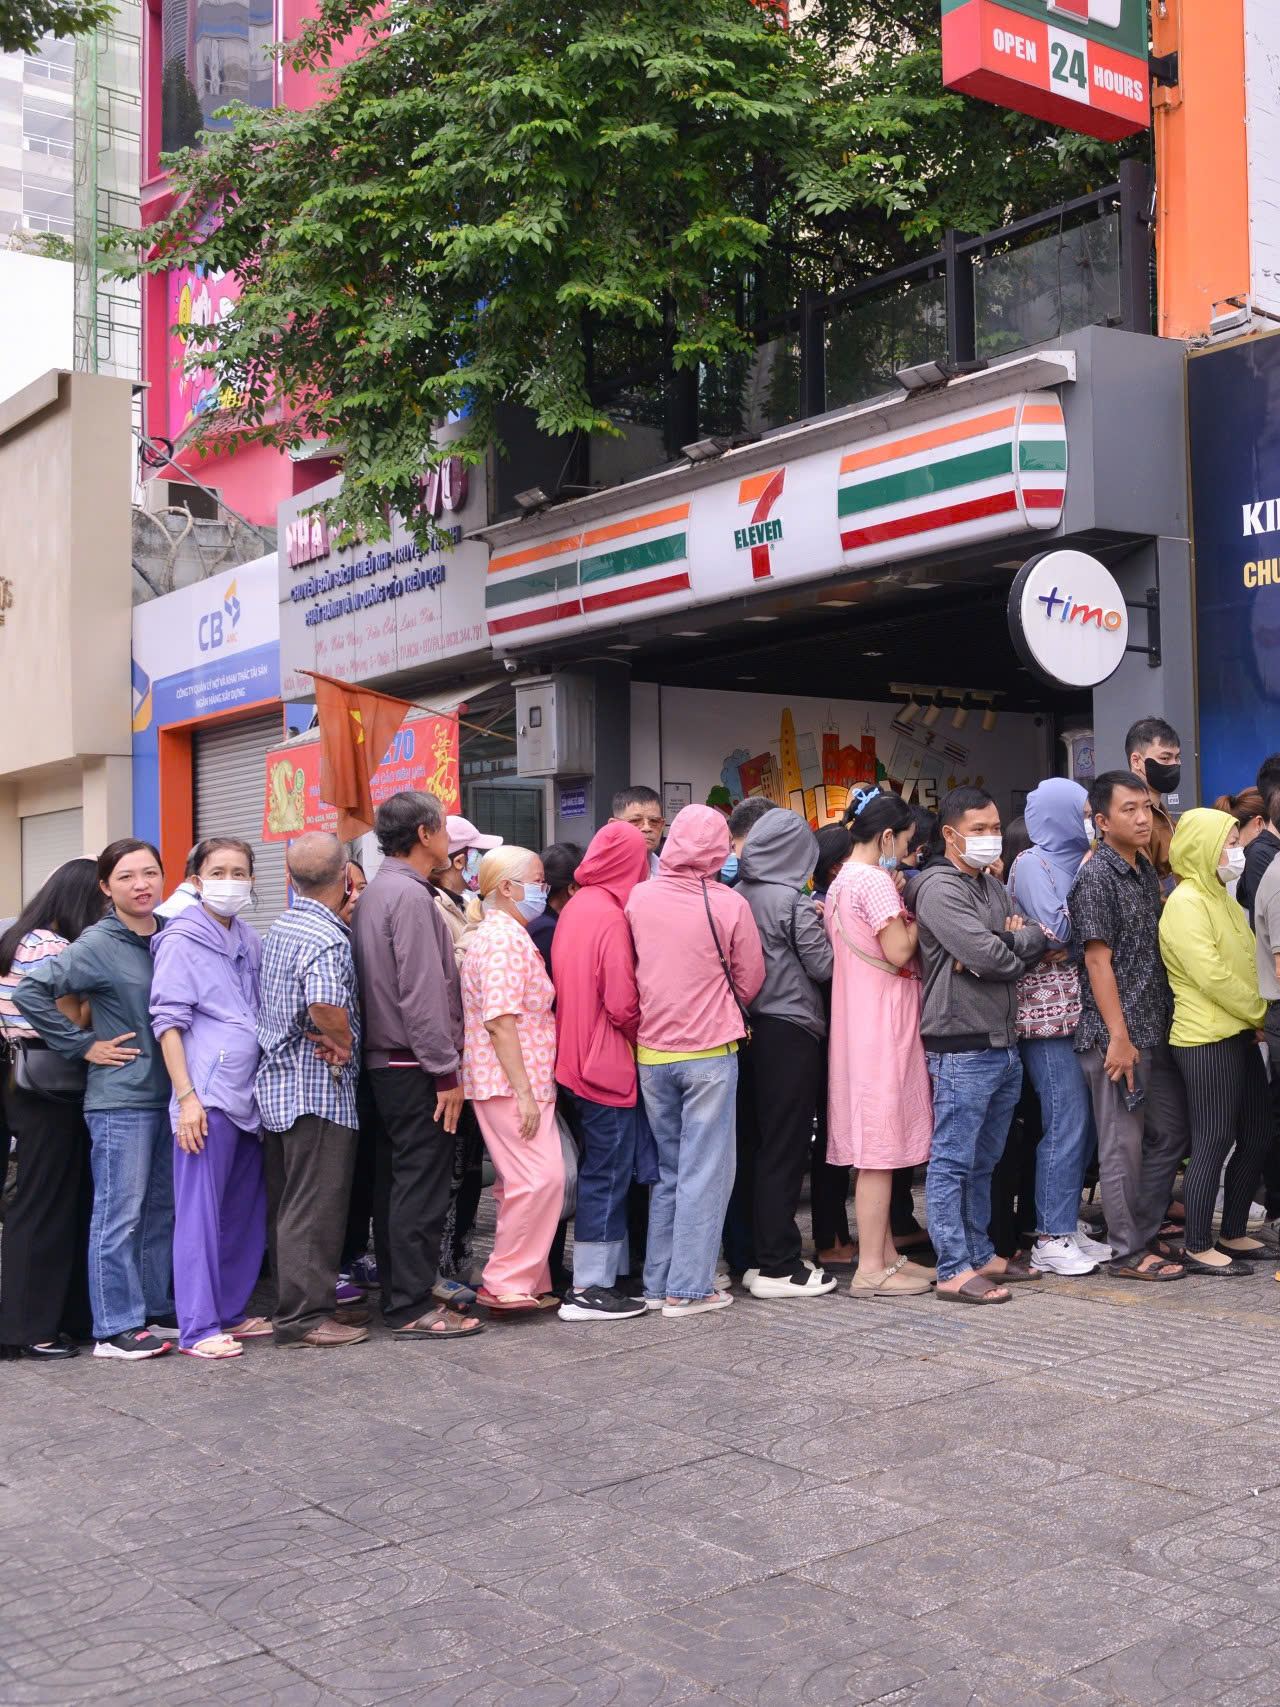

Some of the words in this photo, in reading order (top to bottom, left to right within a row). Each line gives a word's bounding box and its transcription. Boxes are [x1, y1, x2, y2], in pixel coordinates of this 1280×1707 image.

[993, 28, 1037, 63] OPEN
[1051, 42, 1087, 89] 24
[1093, 64, 1144, 102] HOURS
[1038, 587, 1122, 632] timo
[199, 611, 223, 651] CB
[379, 729, 415, 766] 70
